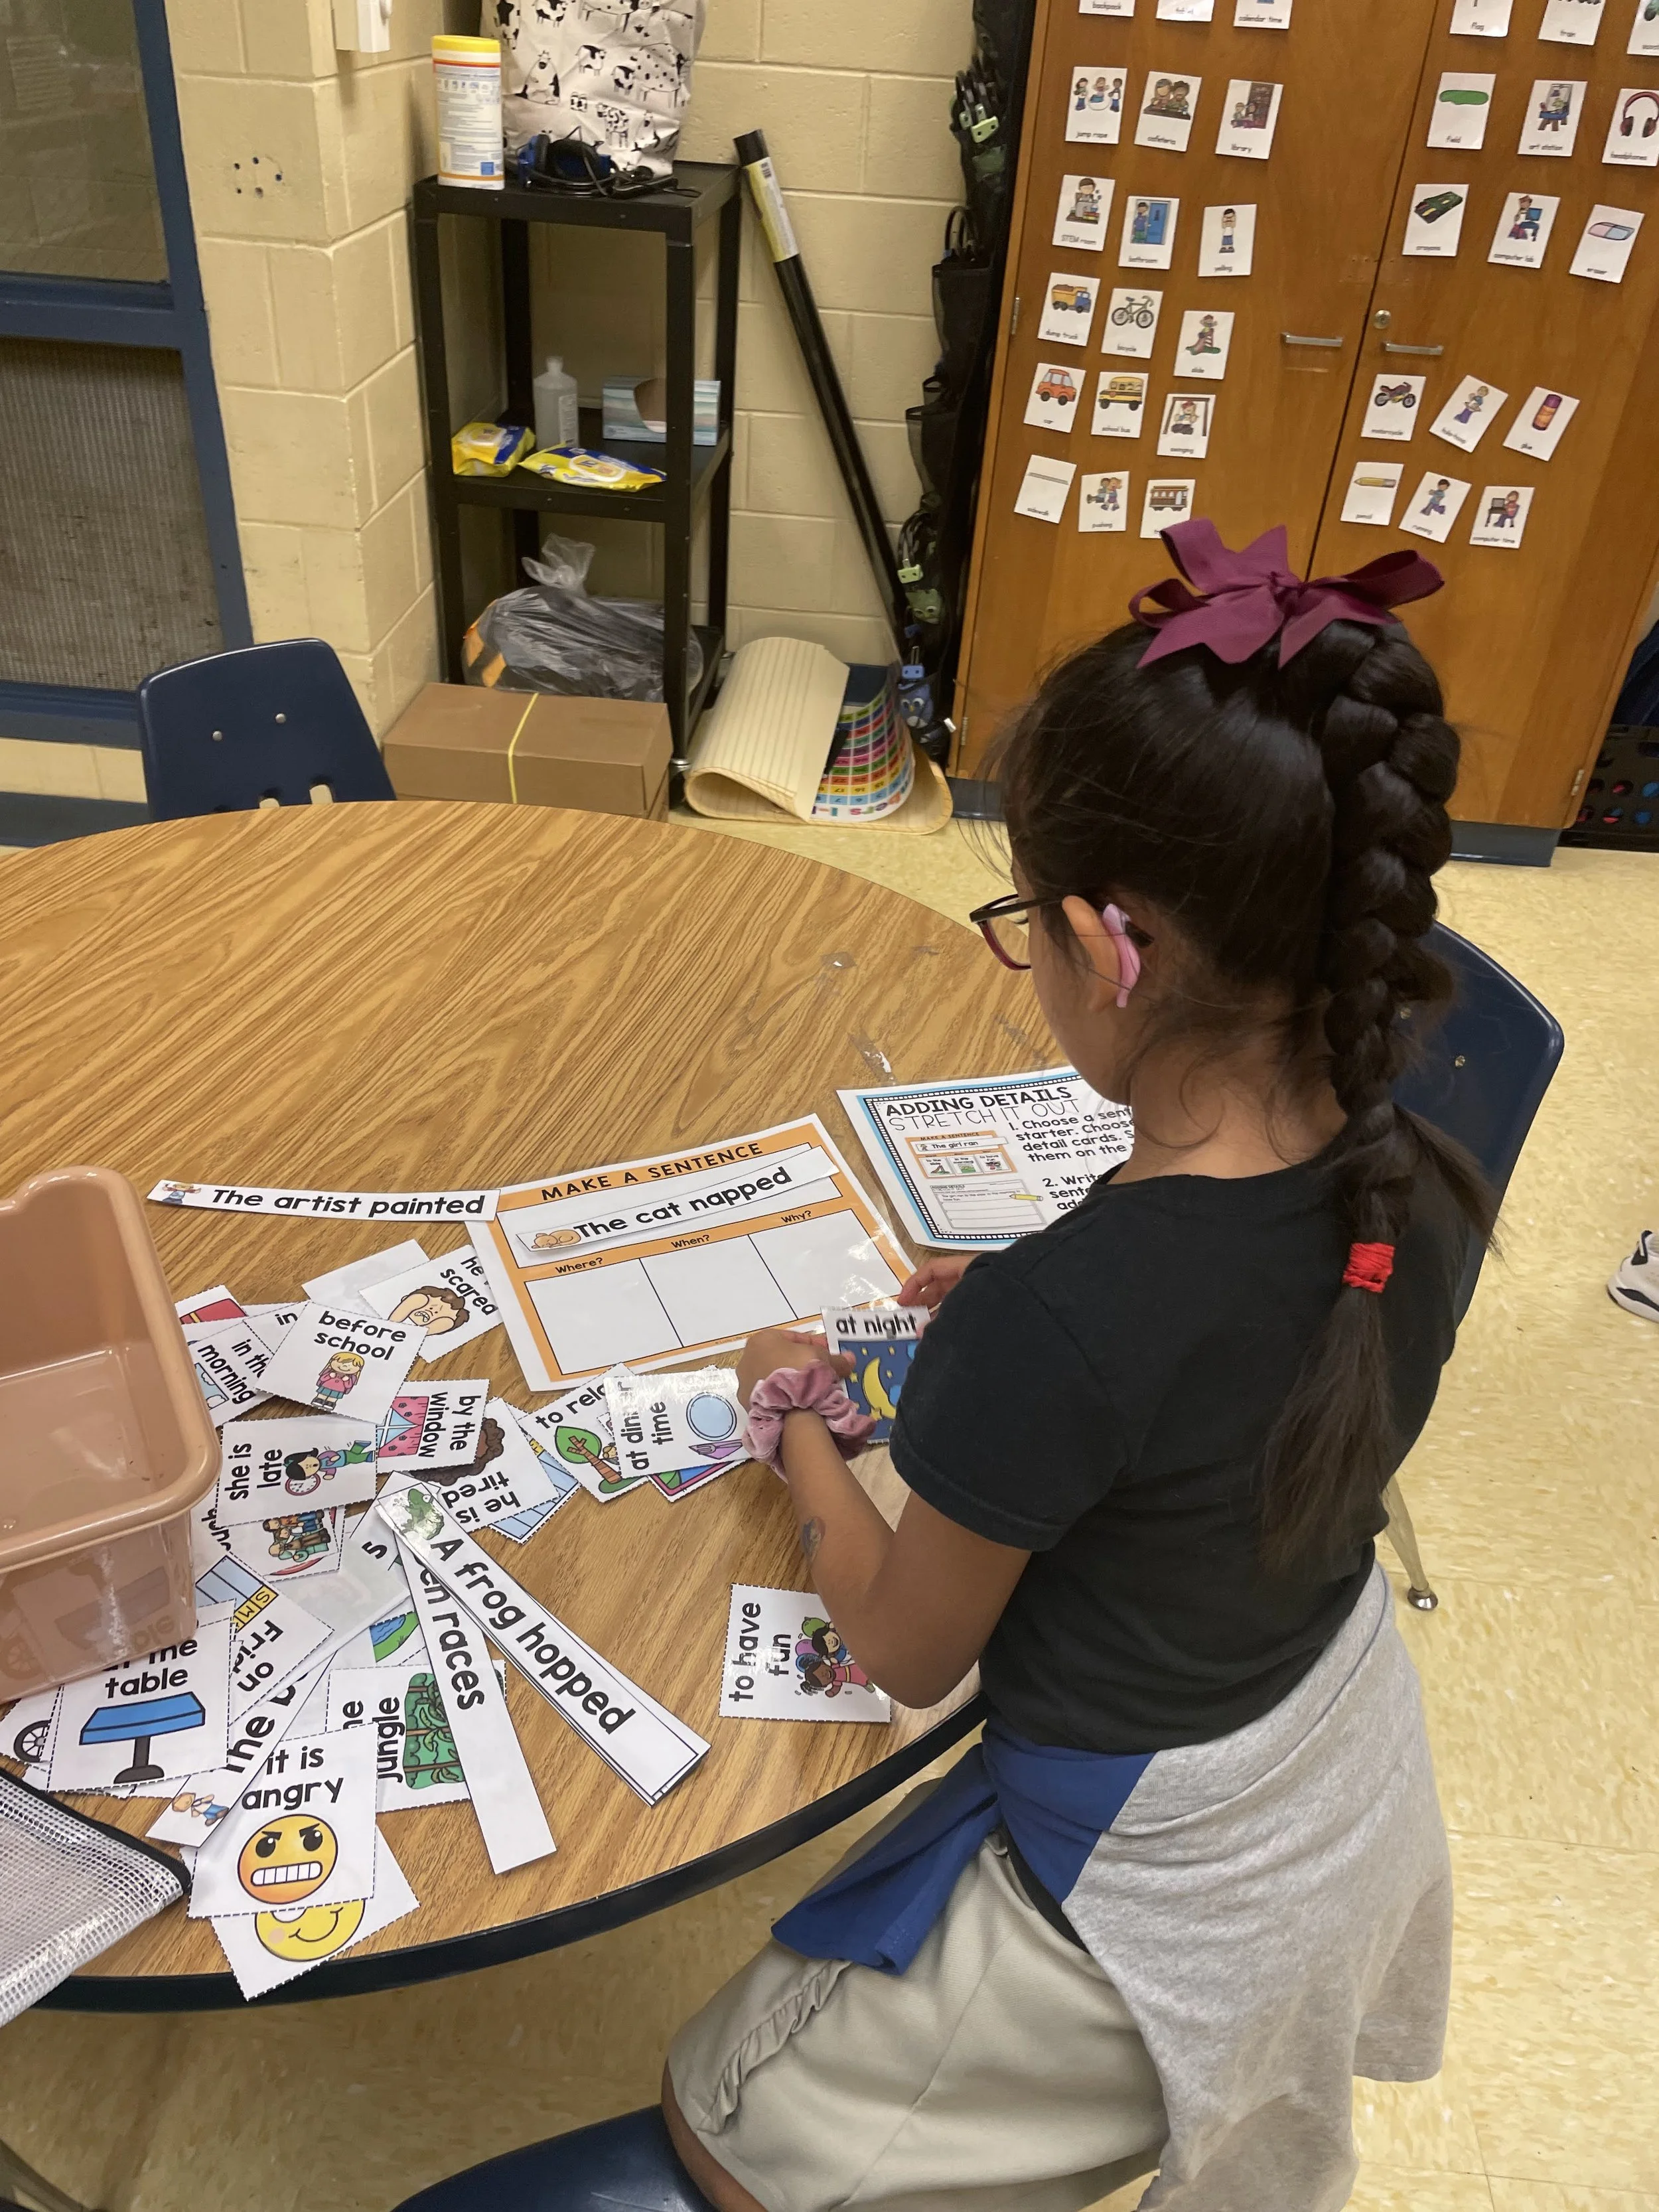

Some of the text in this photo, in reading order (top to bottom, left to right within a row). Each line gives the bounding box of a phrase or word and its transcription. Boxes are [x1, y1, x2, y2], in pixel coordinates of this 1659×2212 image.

[886, 1086, 1072, 1116] ADDING DETAILS
[889, 1098, 1080, 1131] STRETCH IT OUT
[1016, 1118, 1135, 1141] starter. Choose
[1022, 1116, 1079, 1130] Choose
[1023, 1139, 1068, 1151] detail
[1072, 1134, 1122, 1147] cards.
[1028, 1144, 1127, 1162] them on the
[541, 1142, 764, 1201] MAKE A SENTENCE
[1043, 1178, 1058, 1187] 2.
[212, 1189, 485, 1218] The artist painted
[573, 1167, 792, 1238] The cat napped
[1049, 1185, 1090, 1199] sent
[780, 1210, 812, 1223] Why?
[670, 1234, 710, 1249] When?
[461, 1256, 484, 1276] he
[555, 1258, 603, 1274] Where?
[275, 1312, 299, 1326] in
[319, 1310, 406, 1343] before
[836, 1312, 917, 1340] at night
[231, 1339, 270, 1378] in th
[314, 1332, 395, 1361] school
[197, 1344, 257, 1404] morning
[449, 1395, 482, 1451] by the
[535, 1383, 607, 1430] to rel
[650, 1401, 674, 1445] time
[418, 1392, 449, 1458] window
[617, 1380, 650, 1471] at dinr
[224, 1443, 252, 1501] she is
[256, 1449, 283, 1489] late
[441, 1471, 510, 1509] tired
[455, 1491, 521, 1524] he is
[255, 1591, 270, 1603] S
[430, 1538, 636, 1735] A frog hopped
[729, 1603, 761, 1702] to have
[232, 1619, 284, 1692] on Fri
[432, 1611, 485, 1710] races
[105, 1667, 188, 1699] table
[372, 1696, 405, 1783] jungle
[266, 1745, 325, 1775] it is
[242, 1777, 344, 1810] angry
